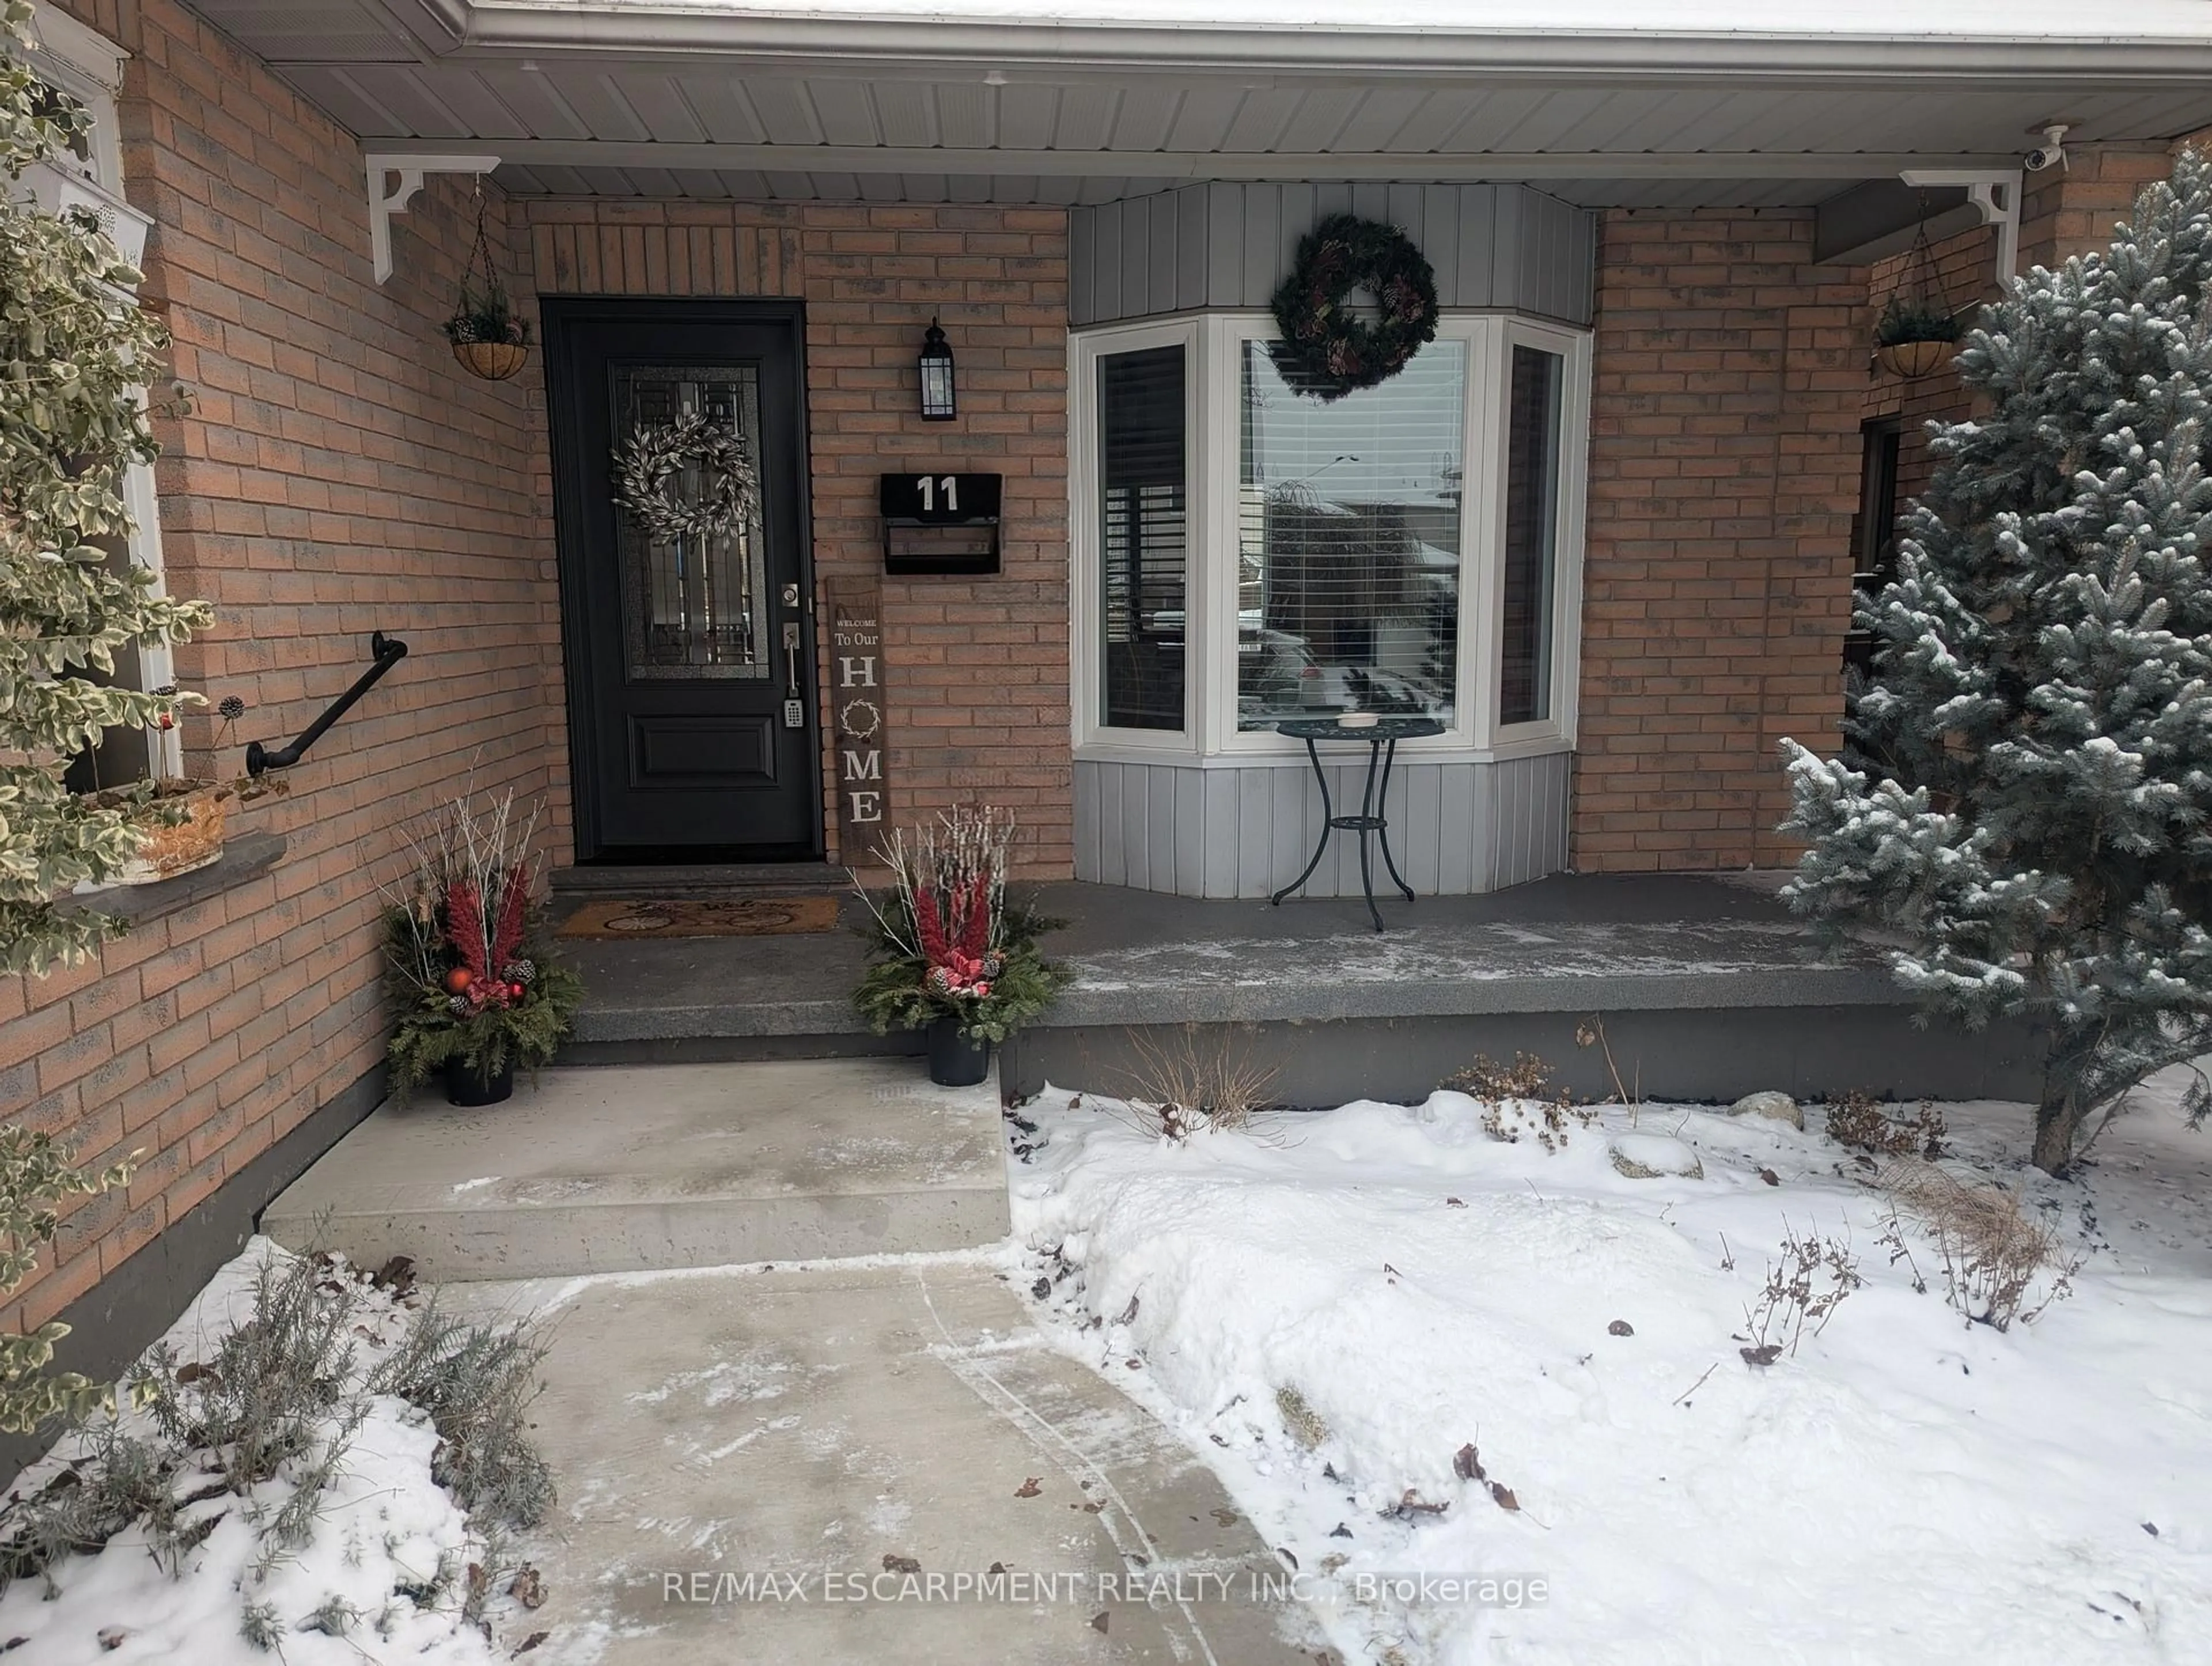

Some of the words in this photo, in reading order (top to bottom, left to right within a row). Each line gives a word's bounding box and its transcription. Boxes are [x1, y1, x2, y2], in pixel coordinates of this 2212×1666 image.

[918, 476, 957, 510] 11
[834, 634, 851, 646] To
[854, 633, 878, 645] Our
